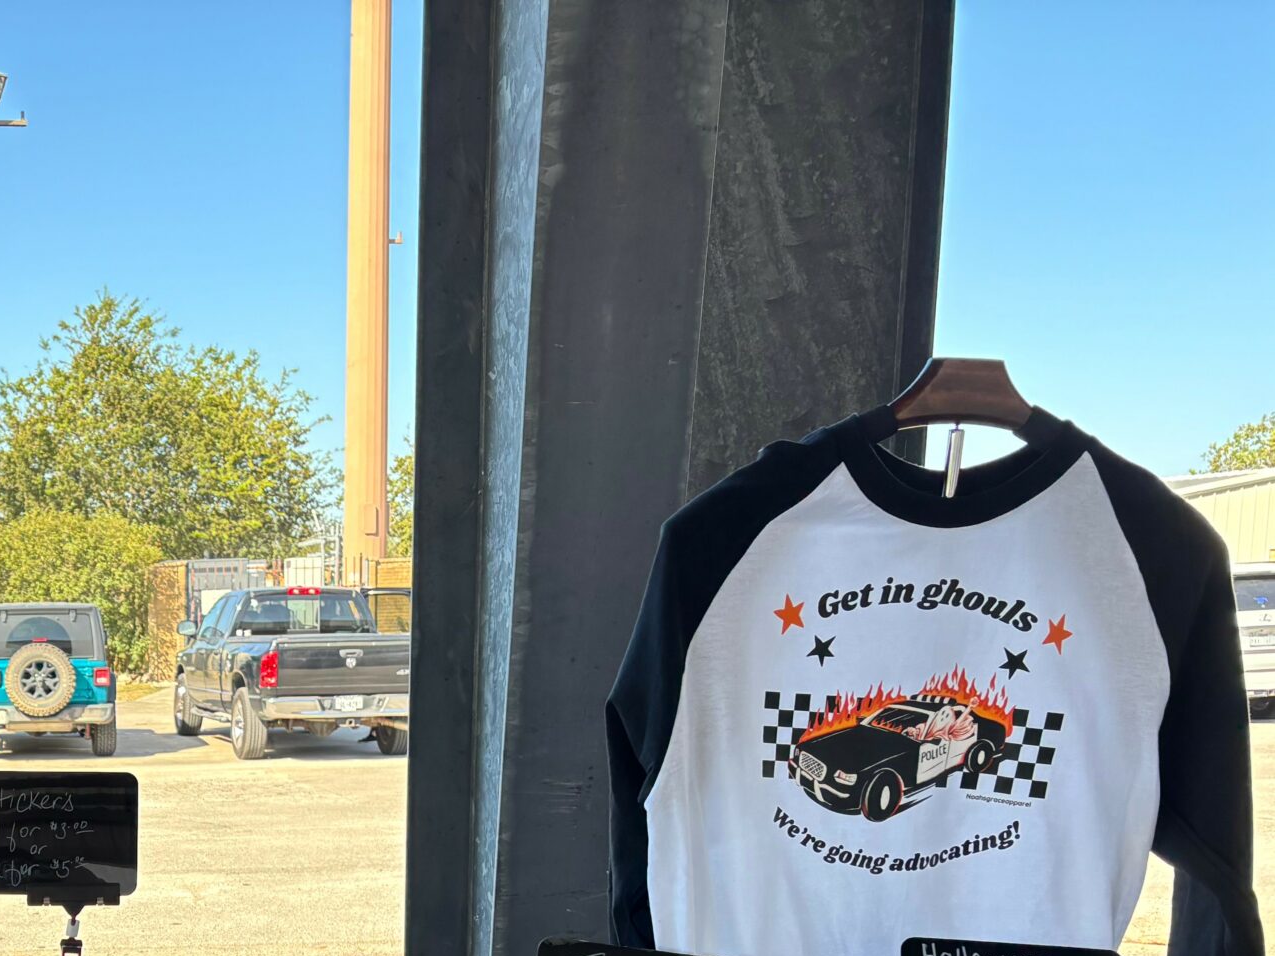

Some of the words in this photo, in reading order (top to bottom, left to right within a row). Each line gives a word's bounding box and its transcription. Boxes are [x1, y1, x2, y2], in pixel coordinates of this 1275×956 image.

[817, 581, 875, 619] Get
[878, 576, 915, 606] in
[916, 578, 1039, 633] ghouls
[919, 743, 947, 764] POLICE
[5, 821, 41, 853] for
[29, 843, 48, 855] or
[771, 805, 826, 854] We're
[822, 844, 890, 876] going
[888, 819, 1022, 873] advocating!
[4, 859, 41, 888] for
